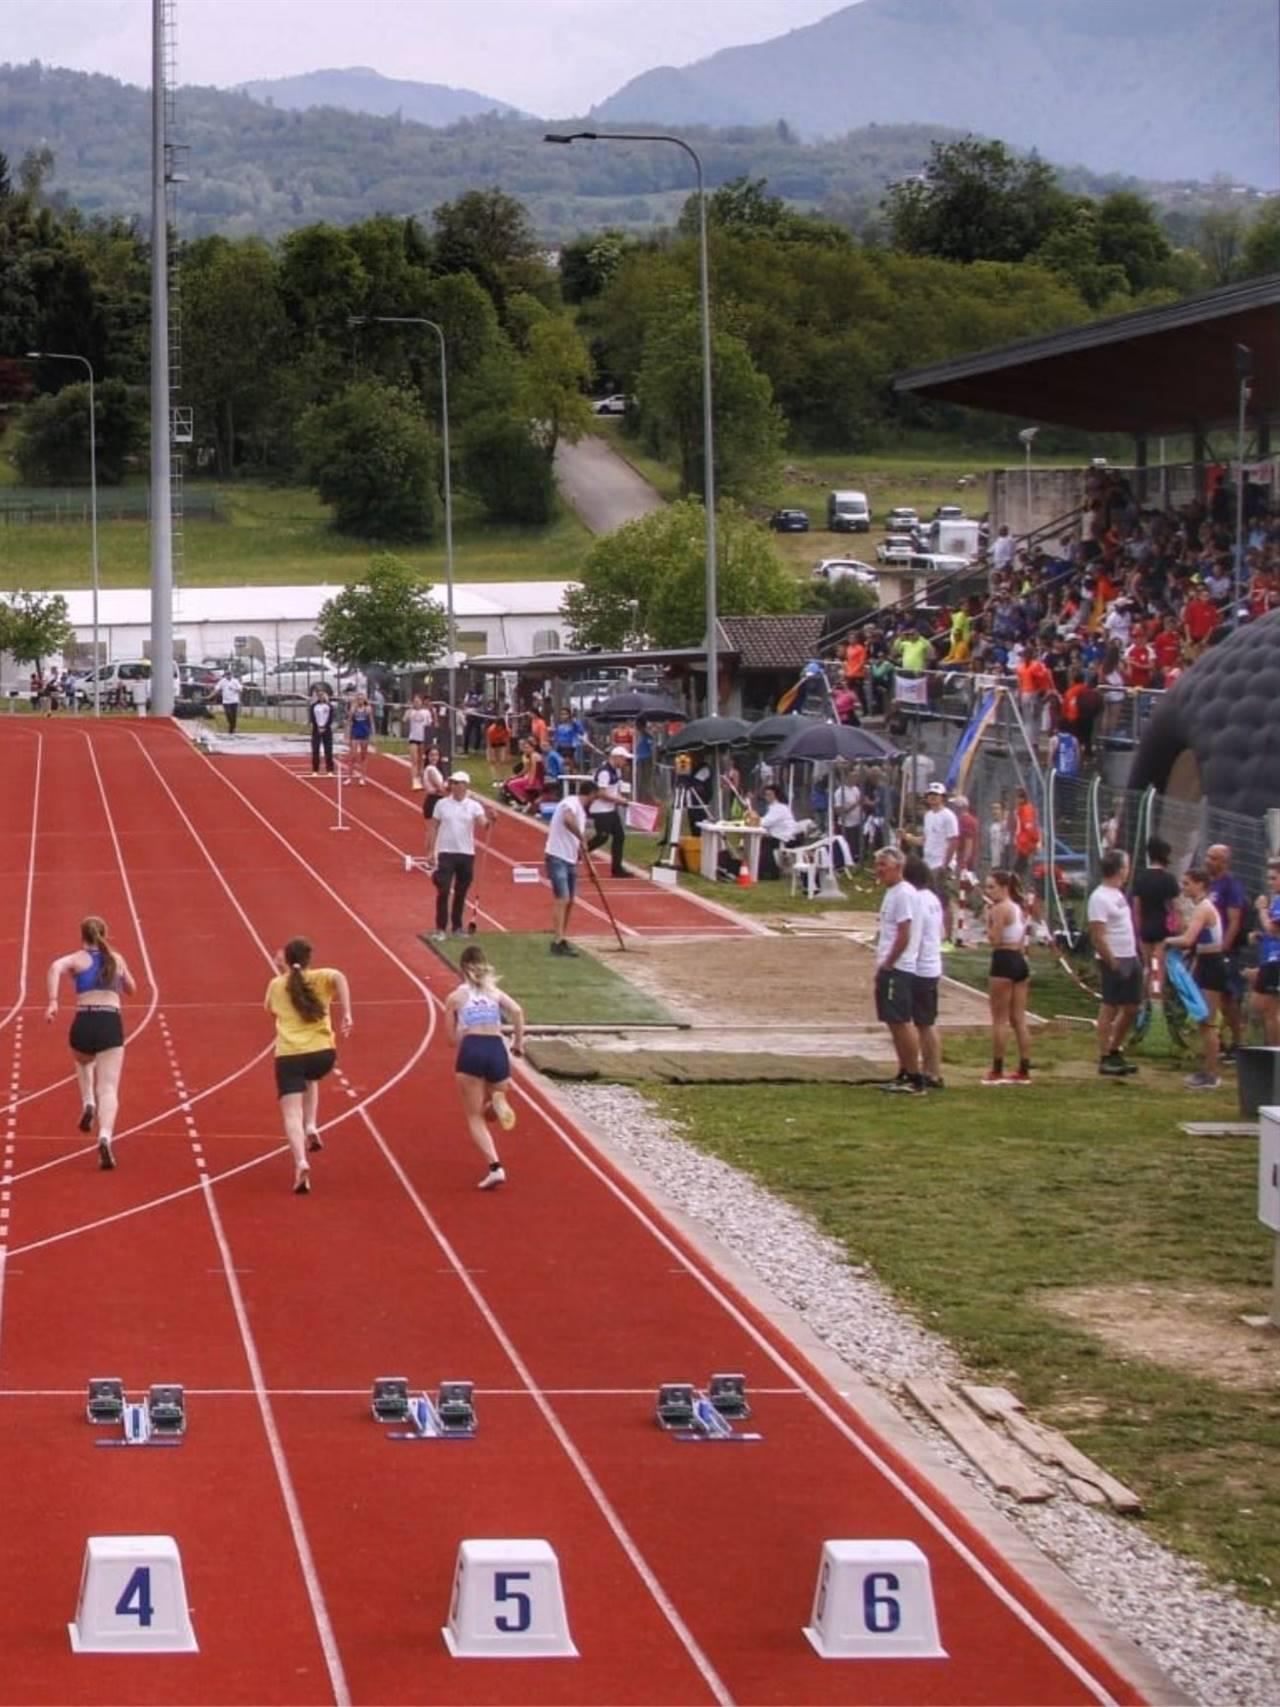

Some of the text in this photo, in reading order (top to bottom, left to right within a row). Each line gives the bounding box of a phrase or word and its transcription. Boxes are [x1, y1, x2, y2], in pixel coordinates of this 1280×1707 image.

[115, 1566, 155, 1627] 4
[494, 1571, 531, 1632] 5
[863, 1571, 901, 1633] 6
